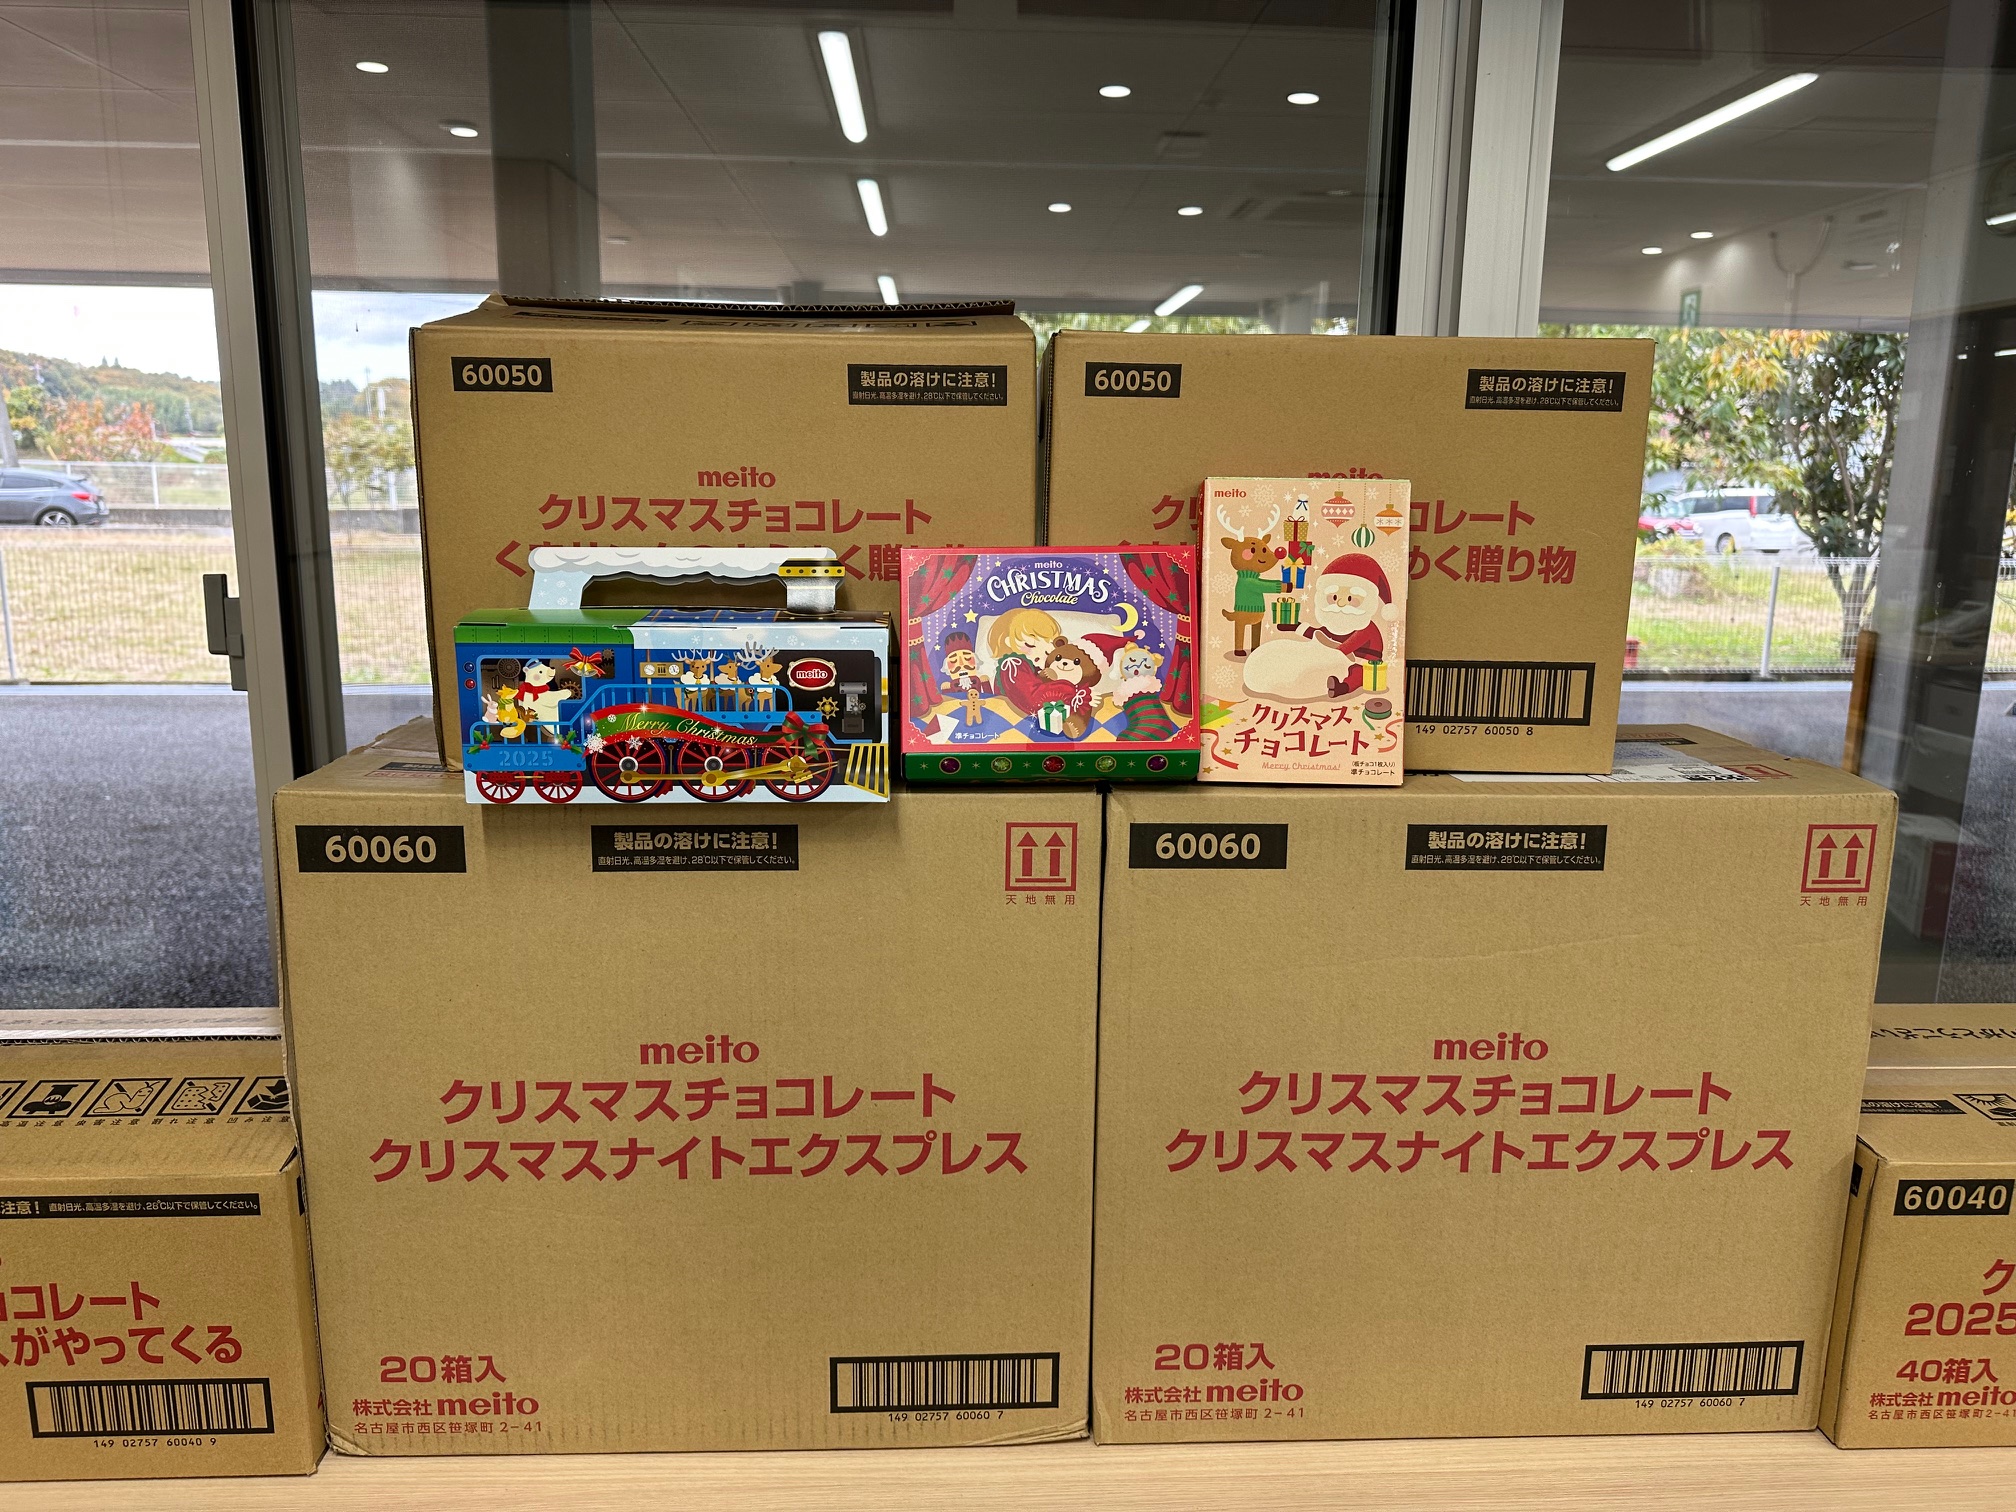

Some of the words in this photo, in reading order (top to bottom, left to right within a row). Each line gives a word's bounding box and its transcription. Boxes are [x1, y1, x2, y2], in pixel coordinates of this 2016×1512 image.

[462, 364, 543, 386] 60050
[860, 371, 996, 388] 製品の溶けに注意!
[1094, 369, 1172, 392] 60050
[1478, 375, 1614, 394] 製品の溶けに注意!
[698, 466, 776, 488] meito
[1213, 489, 1247, 498] meito
[538, 494, 932, 535] クリスマスチョコレート
[1034, 561, 1063, 569] meito
[986, 569, 1112, 602] CHRISTMAS
[1020, 591, 1079, 607] Chocolate
[796, 669, 828, 679] meito
[617, 712, 671, 735] Merry
[676, 718, 758, 746] Christmas
[1252, 703, 1353, 731] クリスマス
[1234, 727, 1370, 758] チョコレート
[1415, 725, 1436, 734] 149
[1442, 725, 1478, 735] 02757
[1484, 726, 1519, 736] 60050
[1526, 727, 1534, 736] 8
[499, 750, 554, 767] 2025
[1261, 762, 1289, 771] Merry
[1292, 762, 1341, 771] Christmas!
[325, 835, 437, 863] 60060
[613, 831, 778, 850] 製品の溶けに注意!
[1155, 832, 1261, 860] 60060
[1427, 831, 1587, 850] 製品の溶けに注意!
[1005, 894, 1076, 905] 天地無用
[1800, 895, 1868, 906] 天地無用
[640, 1034, 760, 1065] meito
[1433, 1031, 1549, 1061] meito
[439, 1072, 956, 1125] クリスマスチョコレート
[1238, 1070, 1733, 1116] クリスマスチョコレート
[369, 1128, 1029, 1183] クリスマスナイトエクスプレス
[1165, 1125, 1794, 1174] クリスマスナイトエクスプレス
[1903, 1185, 2008, 1211] 60040
[0, 1281, 161, 1322] コレート
[1904, 1302, 2016, 1337] 2025
[0, 1325, 243, 1367] がやってくる
[1154, 1342, 1275, 1371] 20箱入
[380, 1354, 507, 1383] 20箱入
[1895, 1358, 1999, 1384] 40箱入
[352, 1398, 433, 1416] 株式会社
[437, 1391, 539, 1416] meito
[1124, 1386, 1202, 1404] 株式会社
[1206, 1378, 1304, 1402] meito
[1635, 1400, 1654, 1408] 149
[1660, 1399, 1693, 1408] 02757
[1700, 1397, 1732, 1407] 60060
[1739, 1397, 1746, 1406] 7
[1869, 1392, 1934, 1407] 株式会社
[1936, 1386, 2016, 1407] meito
[888, 1413, 908, 1421] 149
[915, 1411, 949, 1421] 02757
[956, 1410, 990, 1420] 60060
[998, 1410, 1004, 1419] 7
[94, 1440, 115, 1448] 149
[122, 1438, 159, 1447] 02757
[166, 1437, 203, 1447] 60040
[209, 1437, 217, 1446] 9
